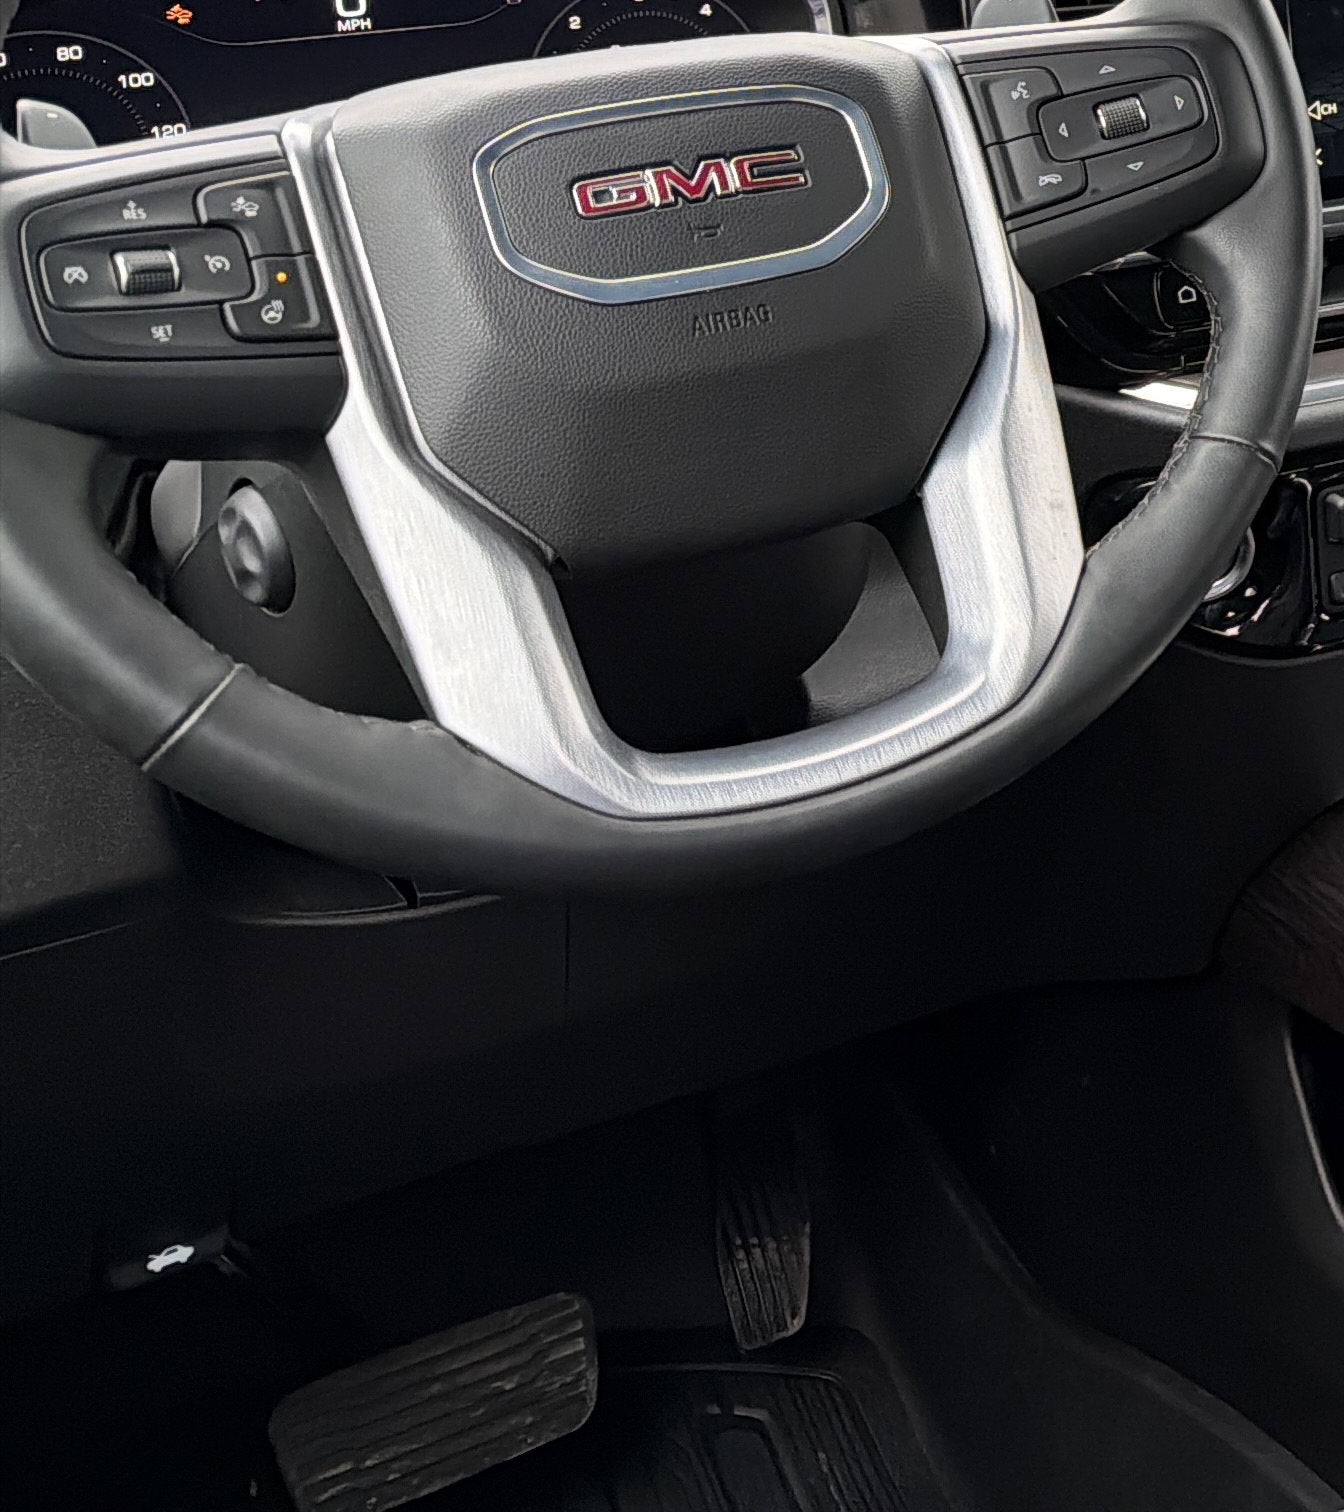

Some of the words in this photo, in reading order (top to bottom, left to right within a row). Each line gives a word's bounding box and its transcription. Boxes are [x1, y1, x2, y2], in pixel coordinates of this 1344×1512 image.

[699, 3, 713, 17] 4
[337, 17, 372, 32] MPH
[568, 15, 581, 30] 2
[56, 45, 83, 62] 80
[117, 72, 154, 89] 100
[1320, 102, 1338, 116] CH
[150, 123, 187, 139] 120
[571, 147, 808, 219] GMC
[122, 208, 148, 221] RES
[692, 303, 774, 338] AIRBAG
[151, 324, 173, 339] SET
